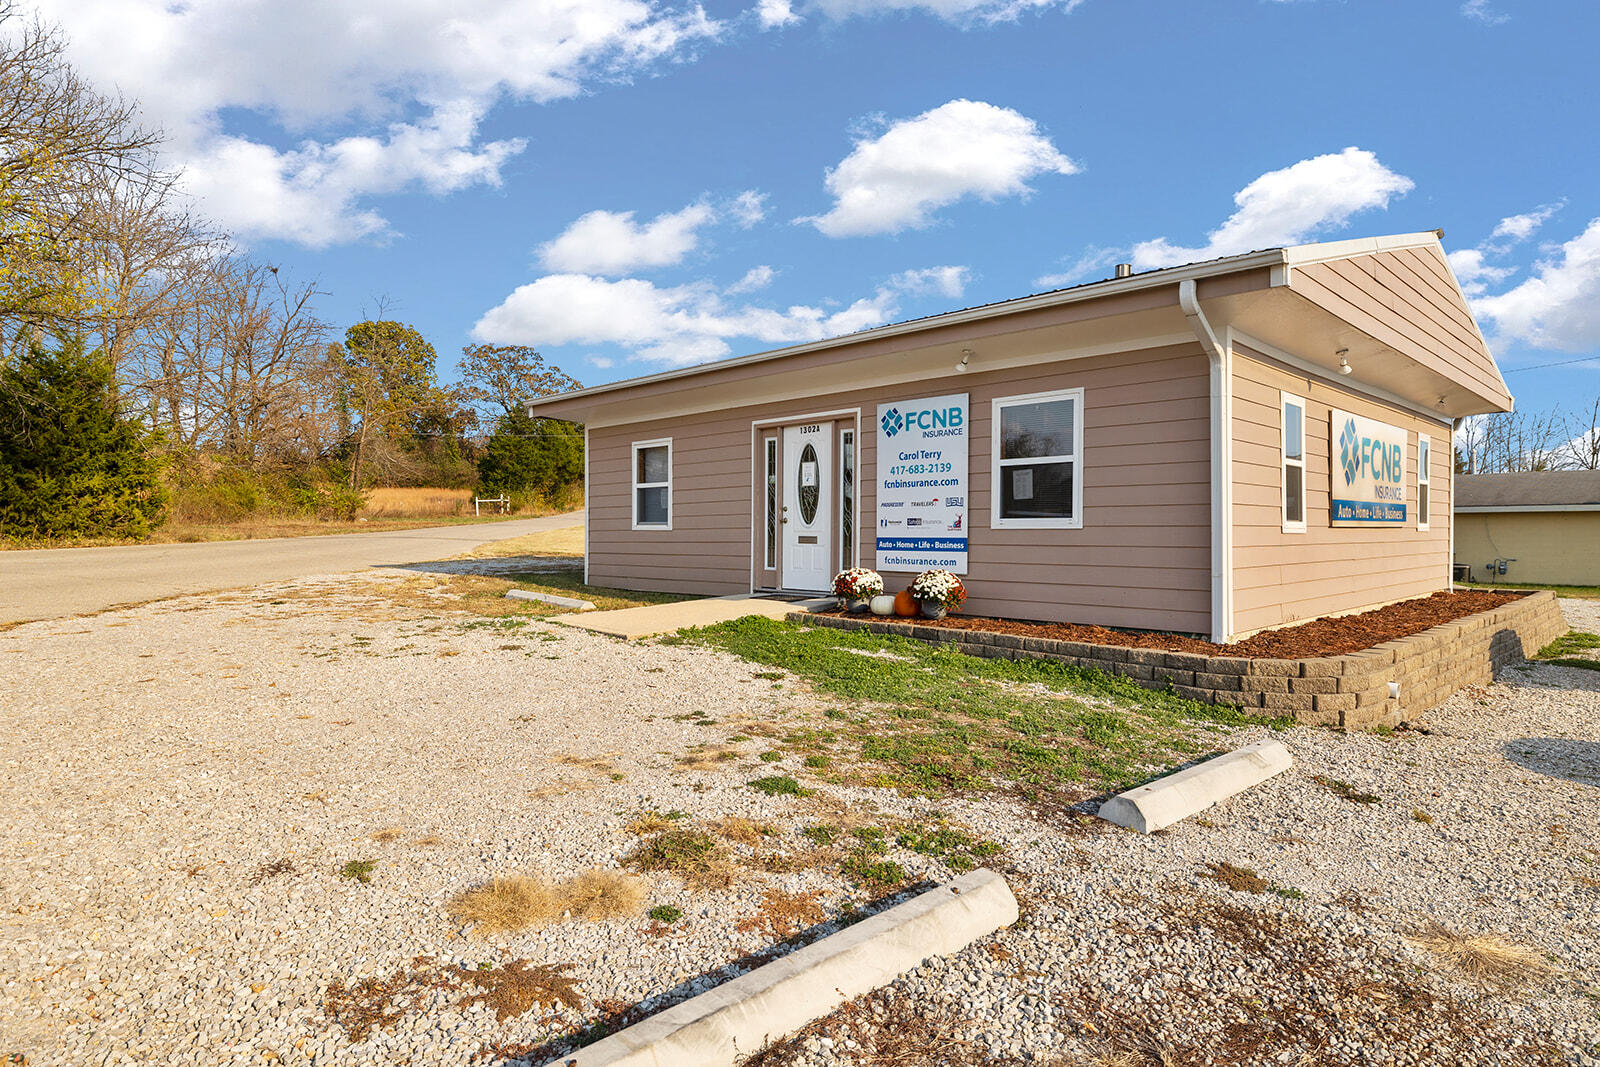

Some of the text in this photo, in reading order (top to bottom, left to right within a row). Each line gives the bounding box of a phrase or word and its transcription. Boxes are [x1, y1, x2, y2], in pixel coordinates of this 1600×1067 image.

[905, 407, 963, 432] FCNB
[800, 425, 820, 434] 1302A
[922, 428, 963, 438] INSURANCE
[899, 450, 942, 461] Carol Terry
[1361, 437, 1402, 483] FCNB
[890, 462, 952, 475] 417-683-2139
[884, 478, 959, 489] fcnbinsurance.com
[1375, 485, 1402, 501] INSURANCE
[1338, 504, 1403, 520] Auto Home Life Business
[896, 541, 914, 549] Home
[918, 541, 931, 549] Life
[934, 541, 965, 549] Business
[884, 556, 957, 566] fcnbinsurance.com
